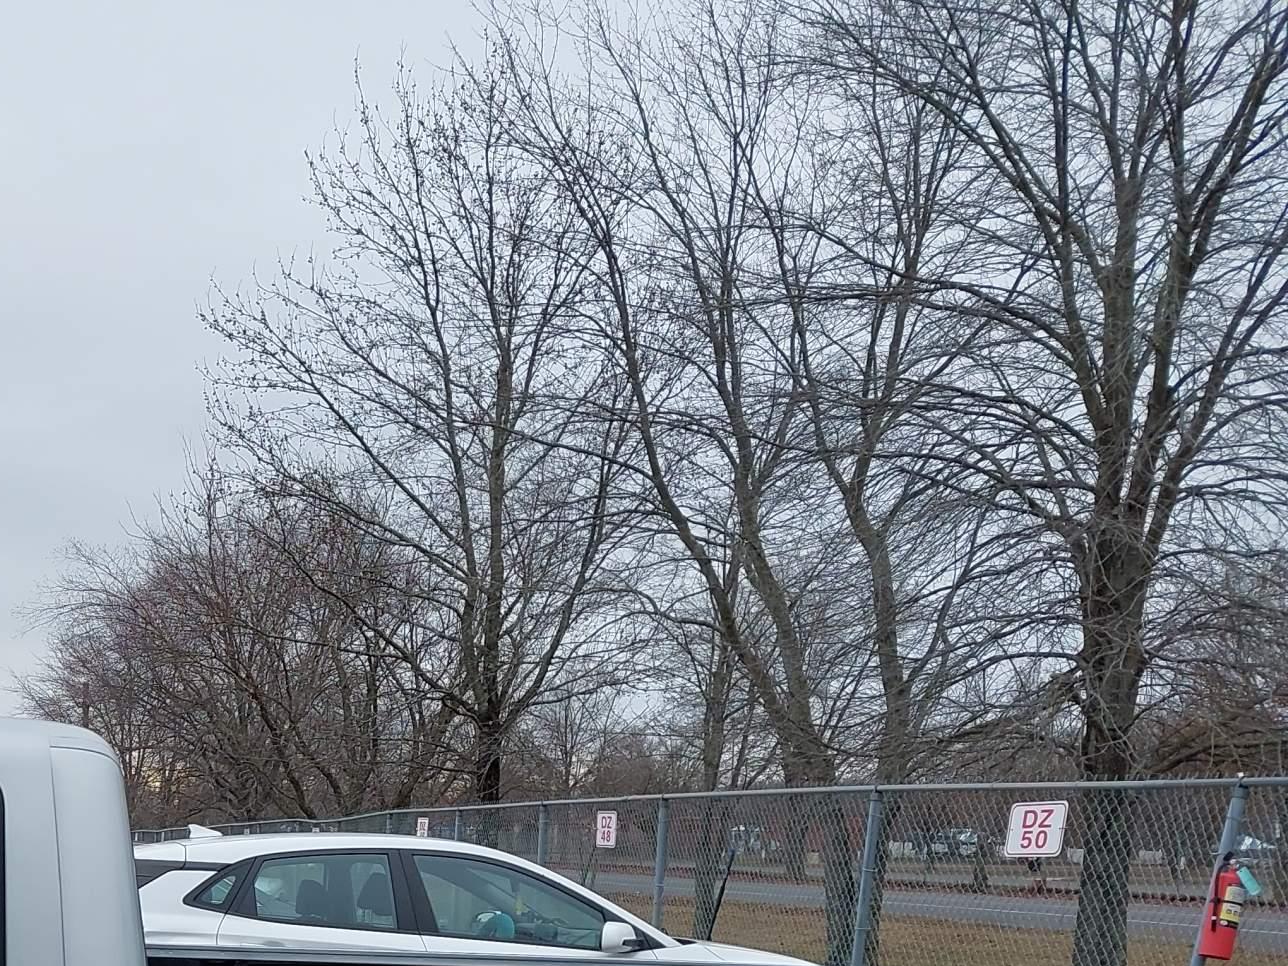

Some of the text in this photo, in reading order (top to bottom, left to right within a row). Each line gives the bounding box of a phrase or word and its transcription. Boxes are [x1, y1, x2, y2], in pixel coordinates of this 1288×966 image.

[601, 815, 613, 829] DZ
[1022, 809, 1055, 829] DZ
[600, 830, 611, 843] 48
[1020, 830, 1048, 849] 50
